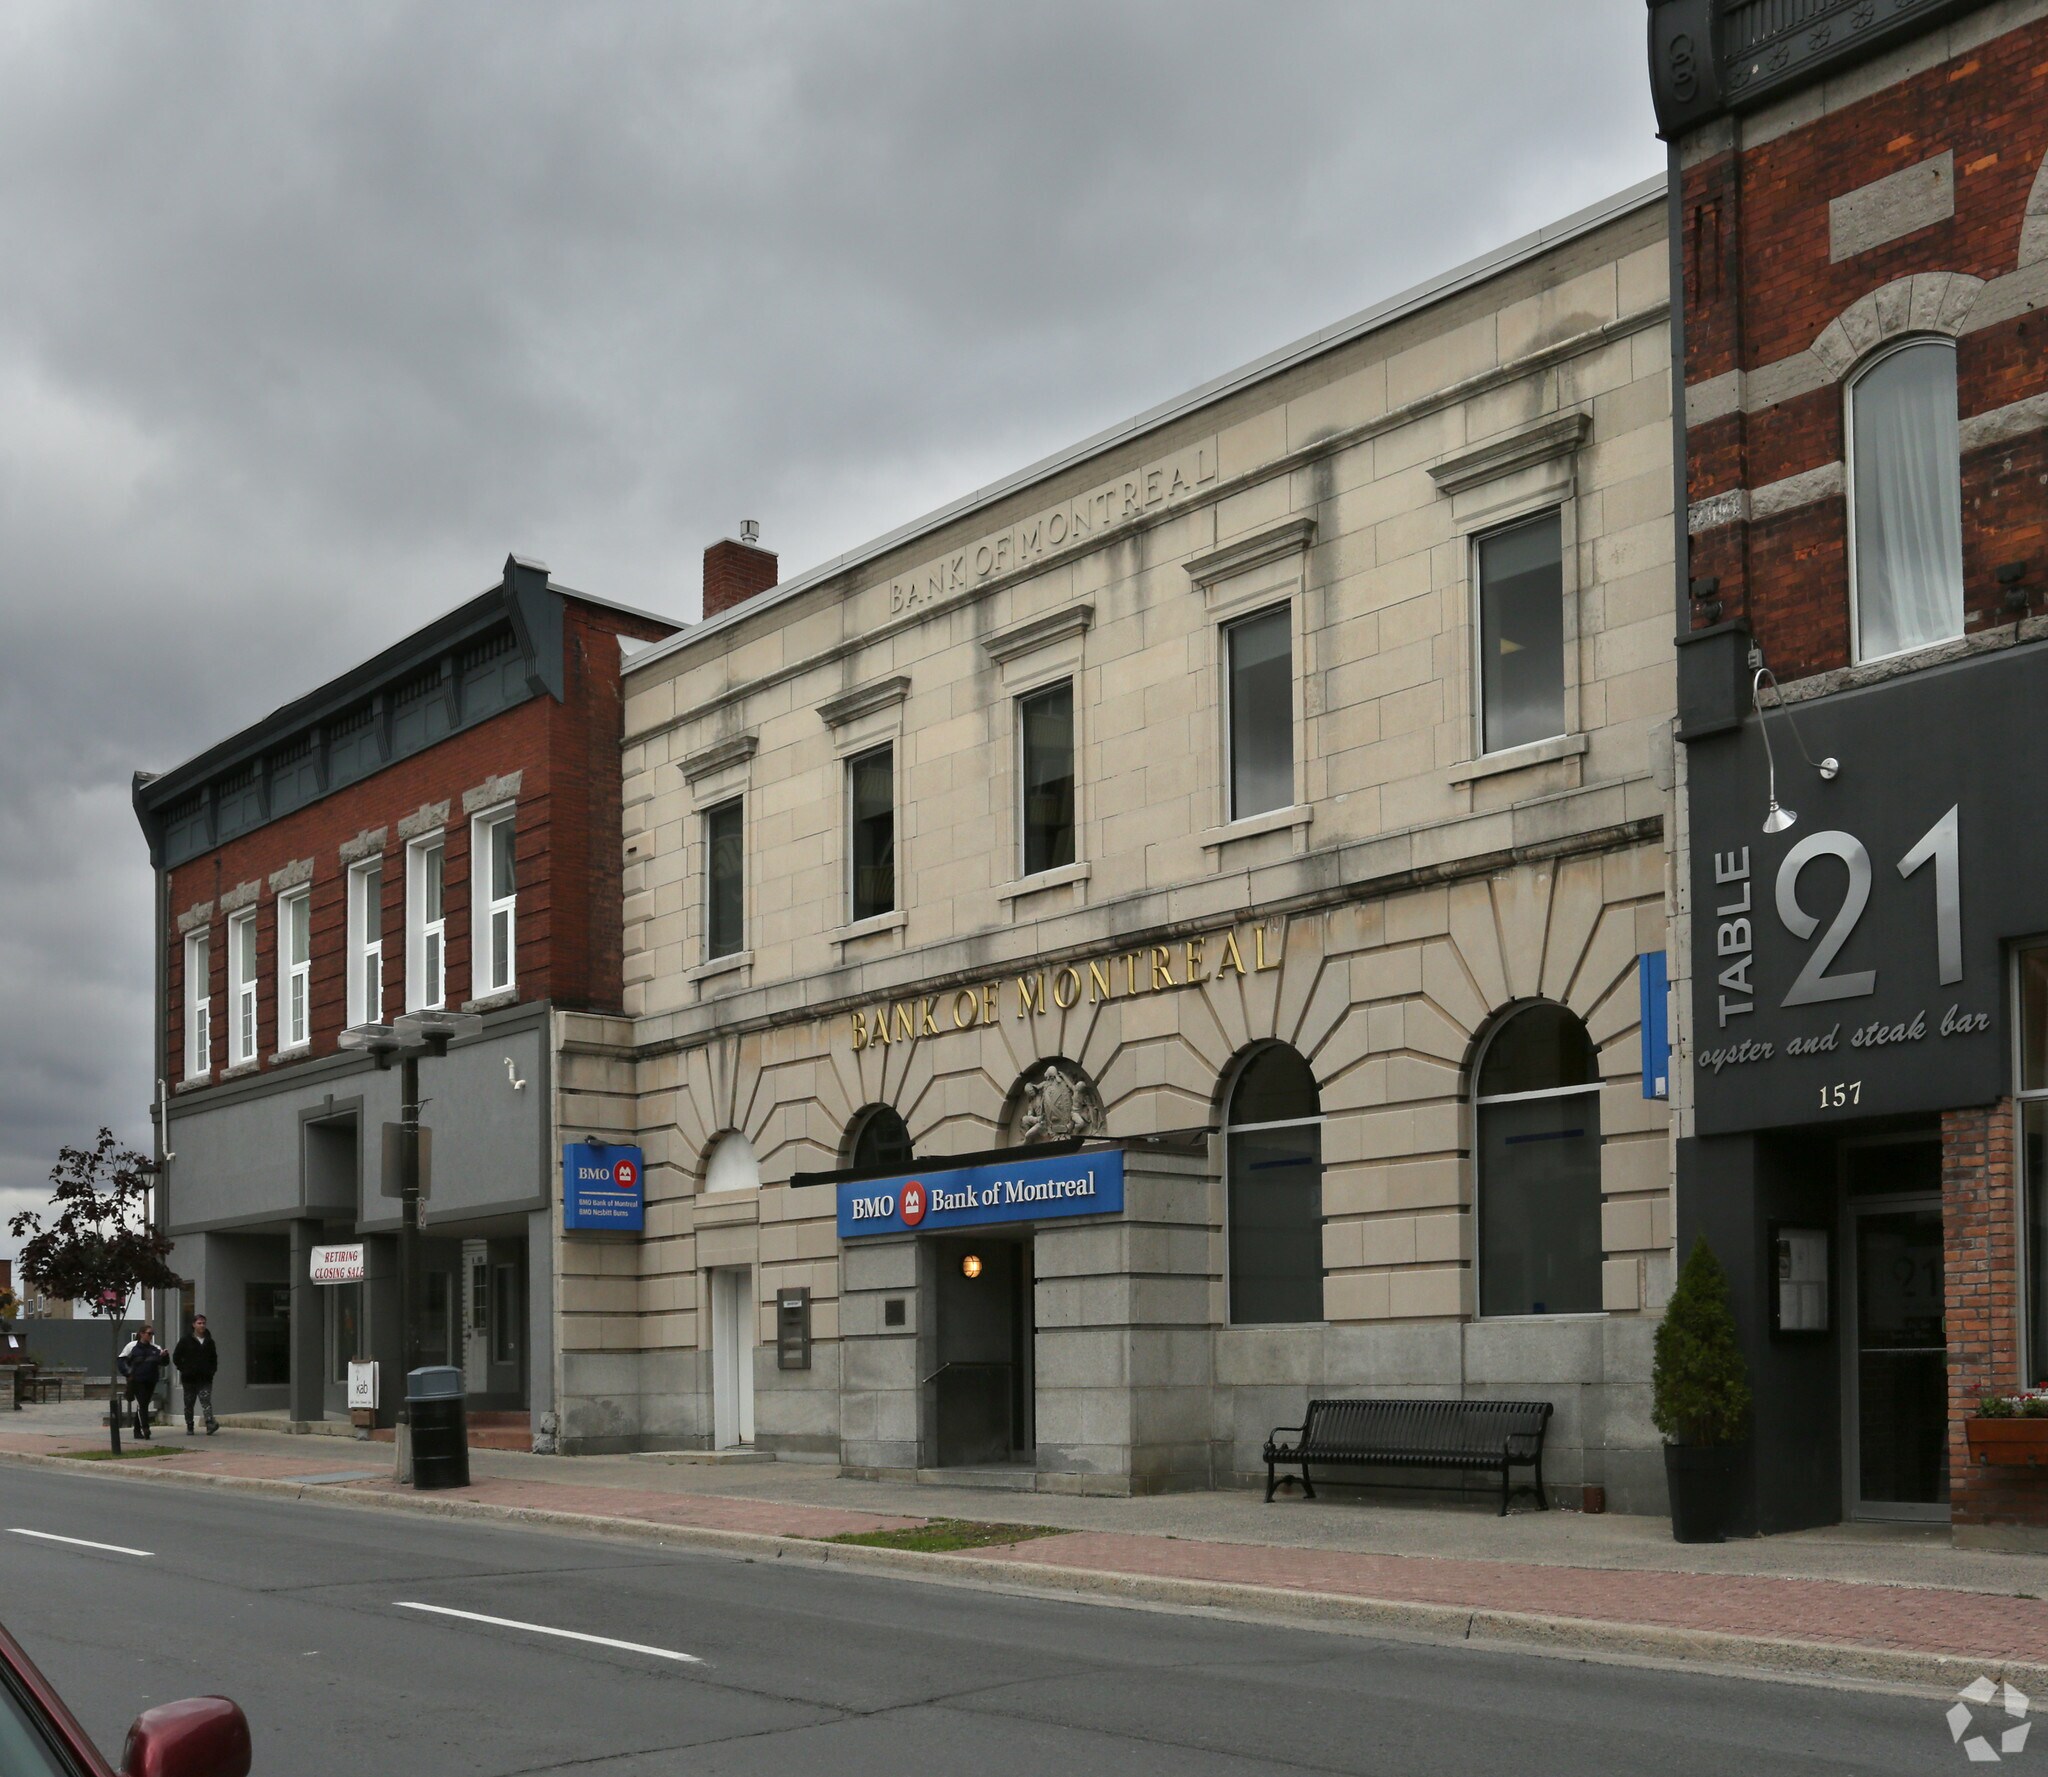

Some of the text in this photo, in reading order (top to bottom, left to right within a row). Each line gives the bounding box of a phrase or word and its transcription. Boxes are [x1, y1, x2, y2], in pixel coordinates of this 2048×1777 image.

[890, 449, 1217, 614] BANK OF MONTREAL
[1775, 802, 1963, 1007] 21
[1714, 845, 1753, 1028] TABLE
[851, 924, 1283, 1052] BANK OF MONTREAL
[1698, 1002, 1991, 1075] oyster and steak bar
[1819, 1080, 1863, 1109] 157
[578, 1167, 610, 1180] BMO
[851, 1171, 1095, 1220] BMO Bank of Montreal
[614, 1200, 638, 1208] Montreal
[314, 1266, 365, 1279] CLOSING SALE
[324, 1250, 358, 1263] RETIRING
